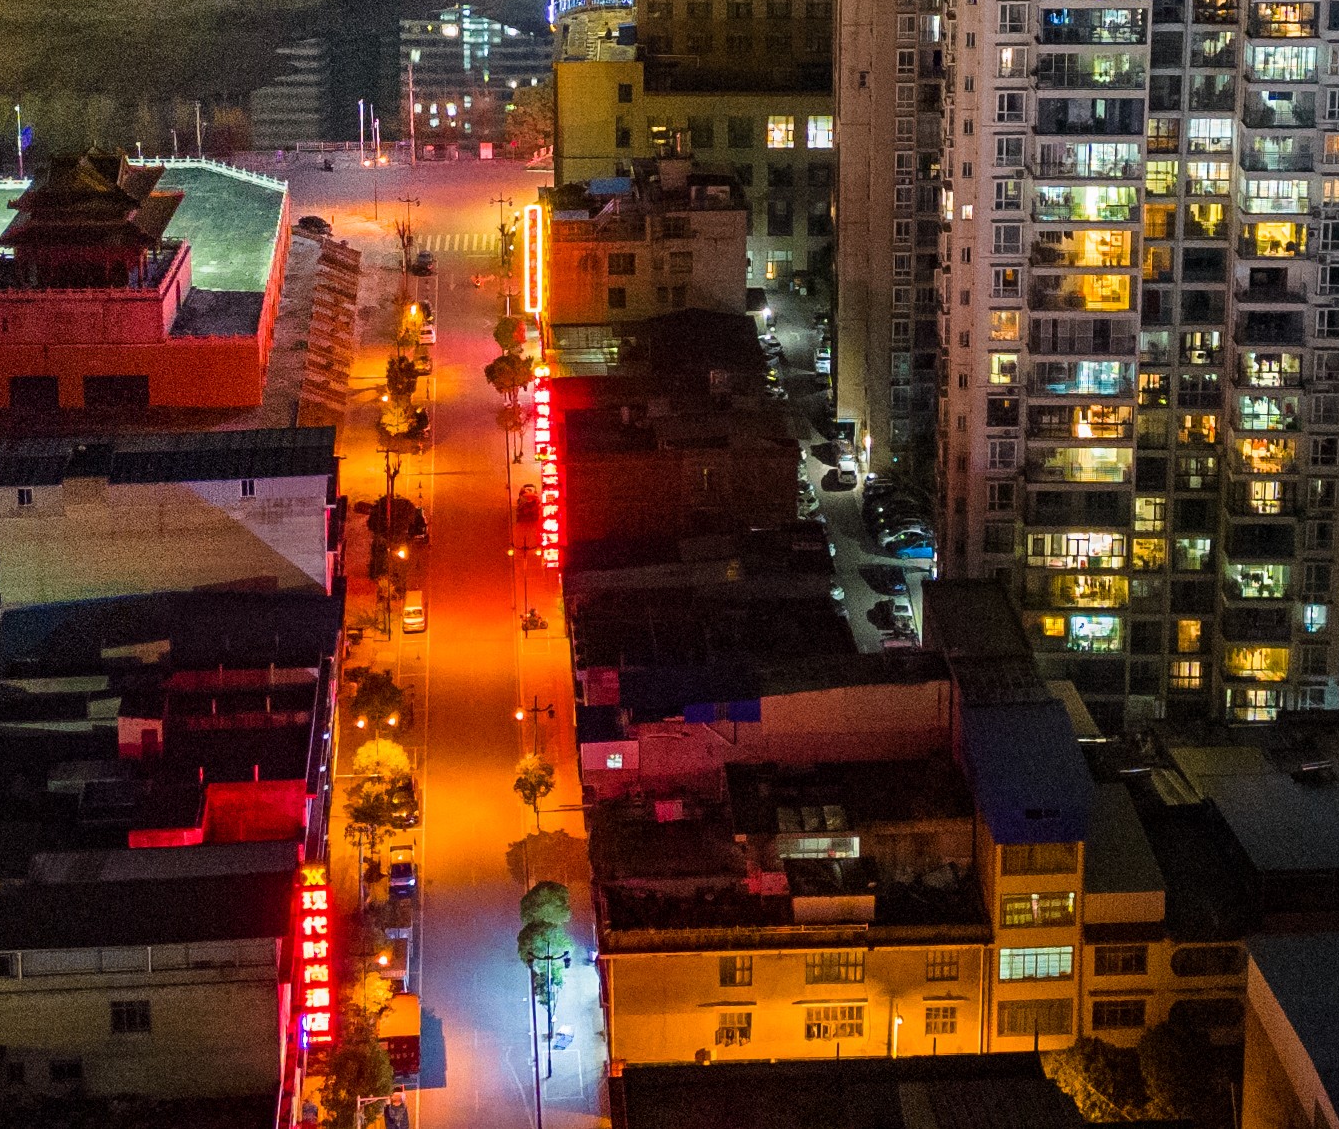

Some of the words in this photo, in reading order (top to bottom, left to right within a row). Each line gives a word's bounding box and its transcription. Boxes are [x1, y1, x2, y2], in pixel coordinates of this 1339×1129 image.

[301, 890, 331, 1032] 现代时尚酒店
